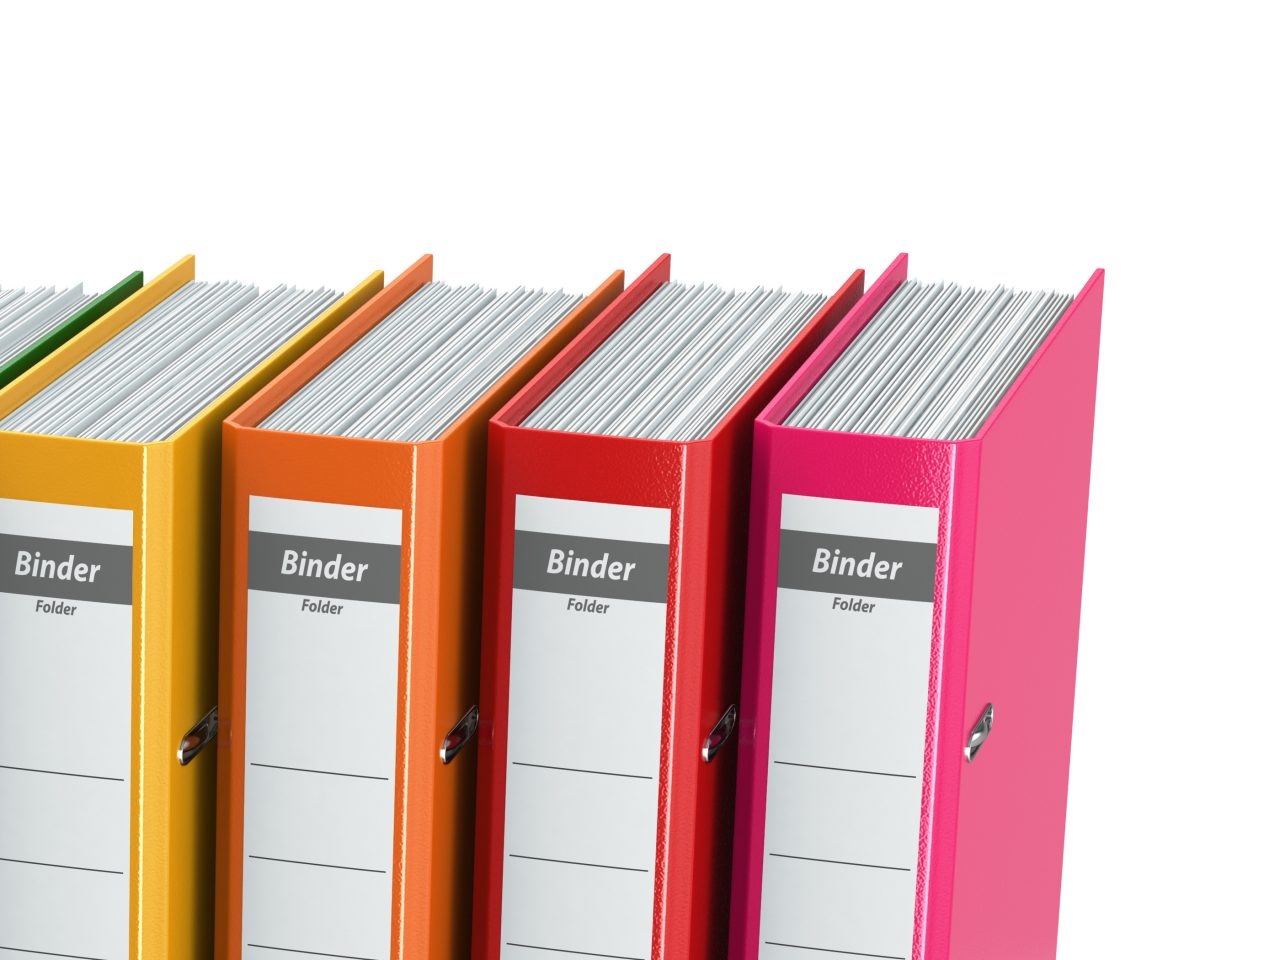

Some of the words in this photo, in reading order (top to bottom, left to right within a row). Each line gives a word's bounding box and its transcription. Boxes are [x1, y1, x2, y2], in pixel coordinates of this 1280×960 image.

[15, 551, 101, 582] Binder
[281, 550, 368, 581] Binder
[547, 549, 636, 580] Binder
[813, 548, 903, 580] Binder
[36, 600, 77, 615] Folder
[302, 599, 343, 614] Folder
[567, 598, 609, 614] Folder
[832, 597, 875, 613] Folder
